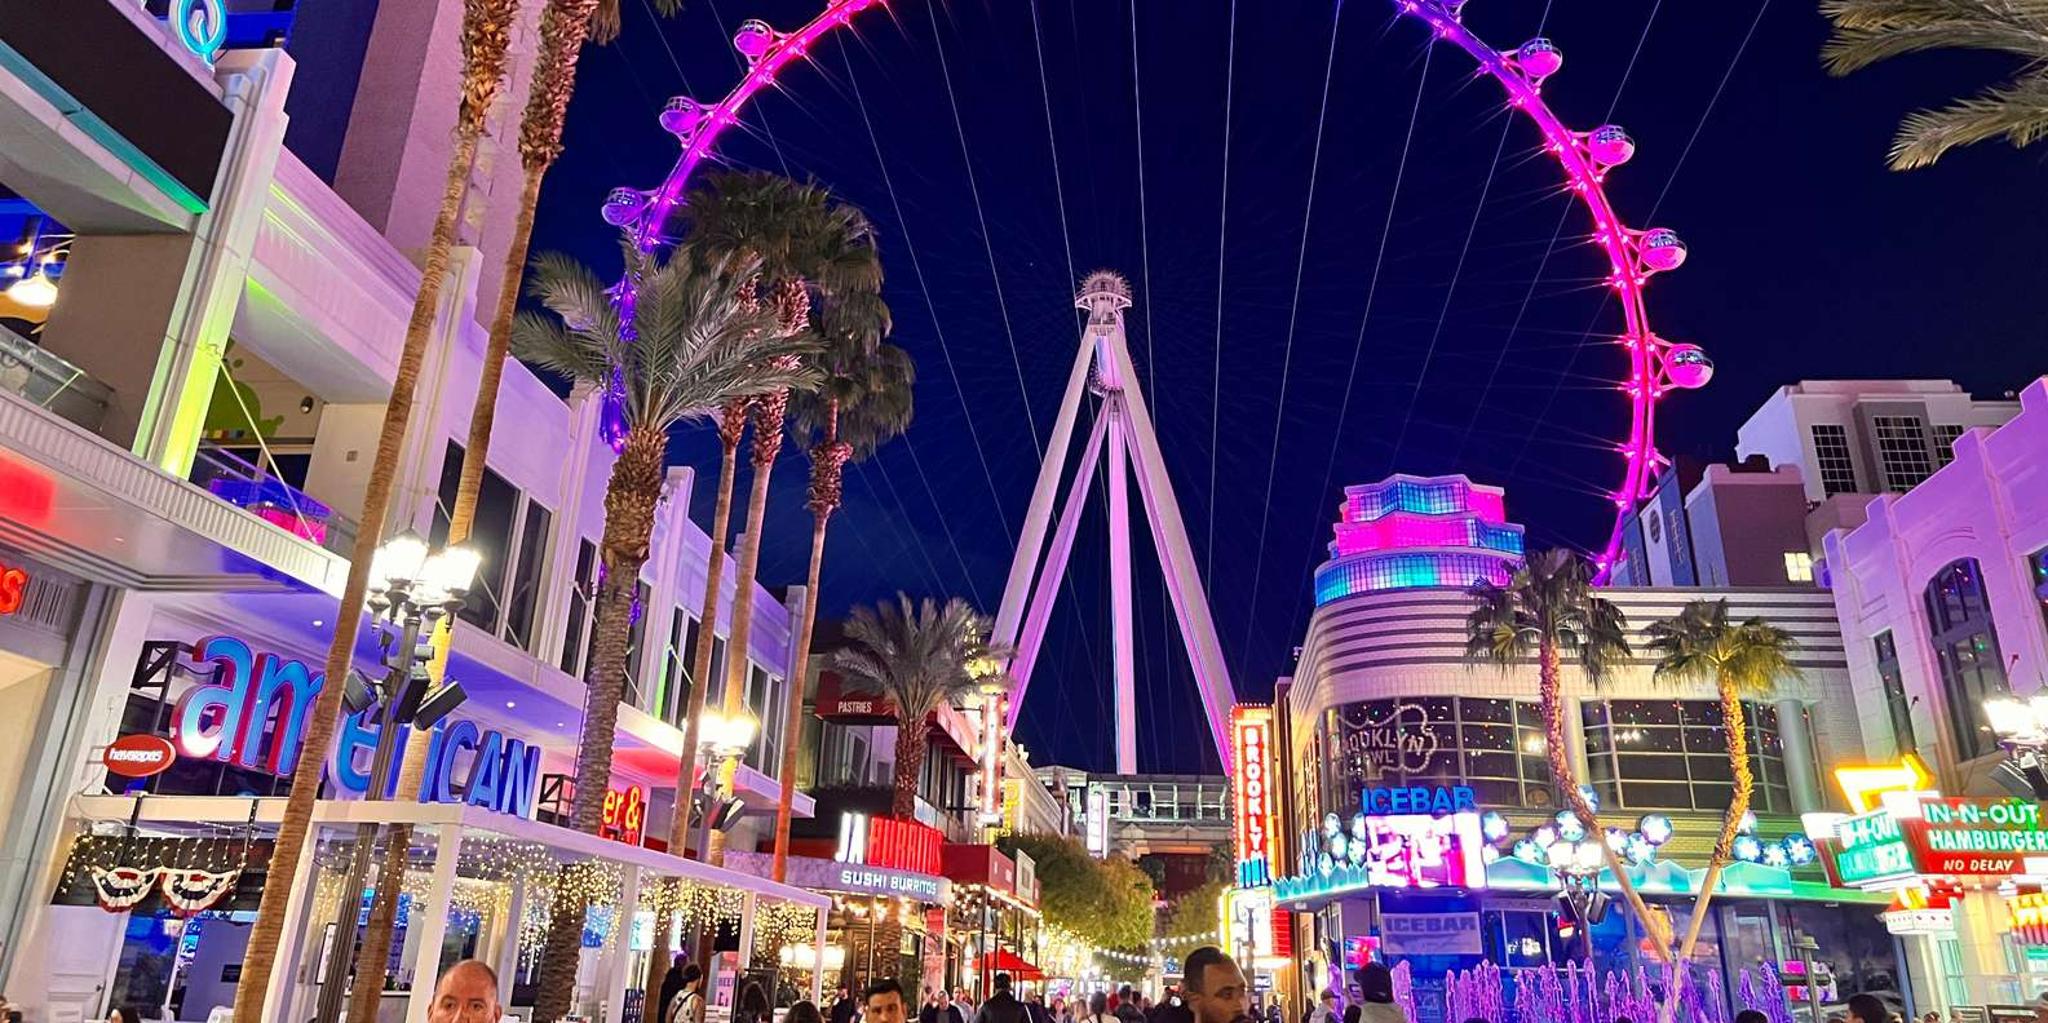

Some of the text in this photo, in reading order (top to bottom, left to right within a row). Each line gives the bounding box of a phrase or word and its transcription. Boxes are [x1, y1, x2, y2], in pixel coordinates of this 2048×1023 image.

[838, 701, 872, 713] PASTRIES
[625, 786, 641, 832] &
[1362, 786, 1475, 815] ICEBAR
[1922, 803, 2039, 824] IN-N-OUT
[1927, 829, 2048, 852] HAMBURGER
[1943, 859, 2014, 872] NO DELAY
[842, 870, 937, 896] SUSHI BURRITOS
[1386, 916, 1476, 932] ICEBAR
